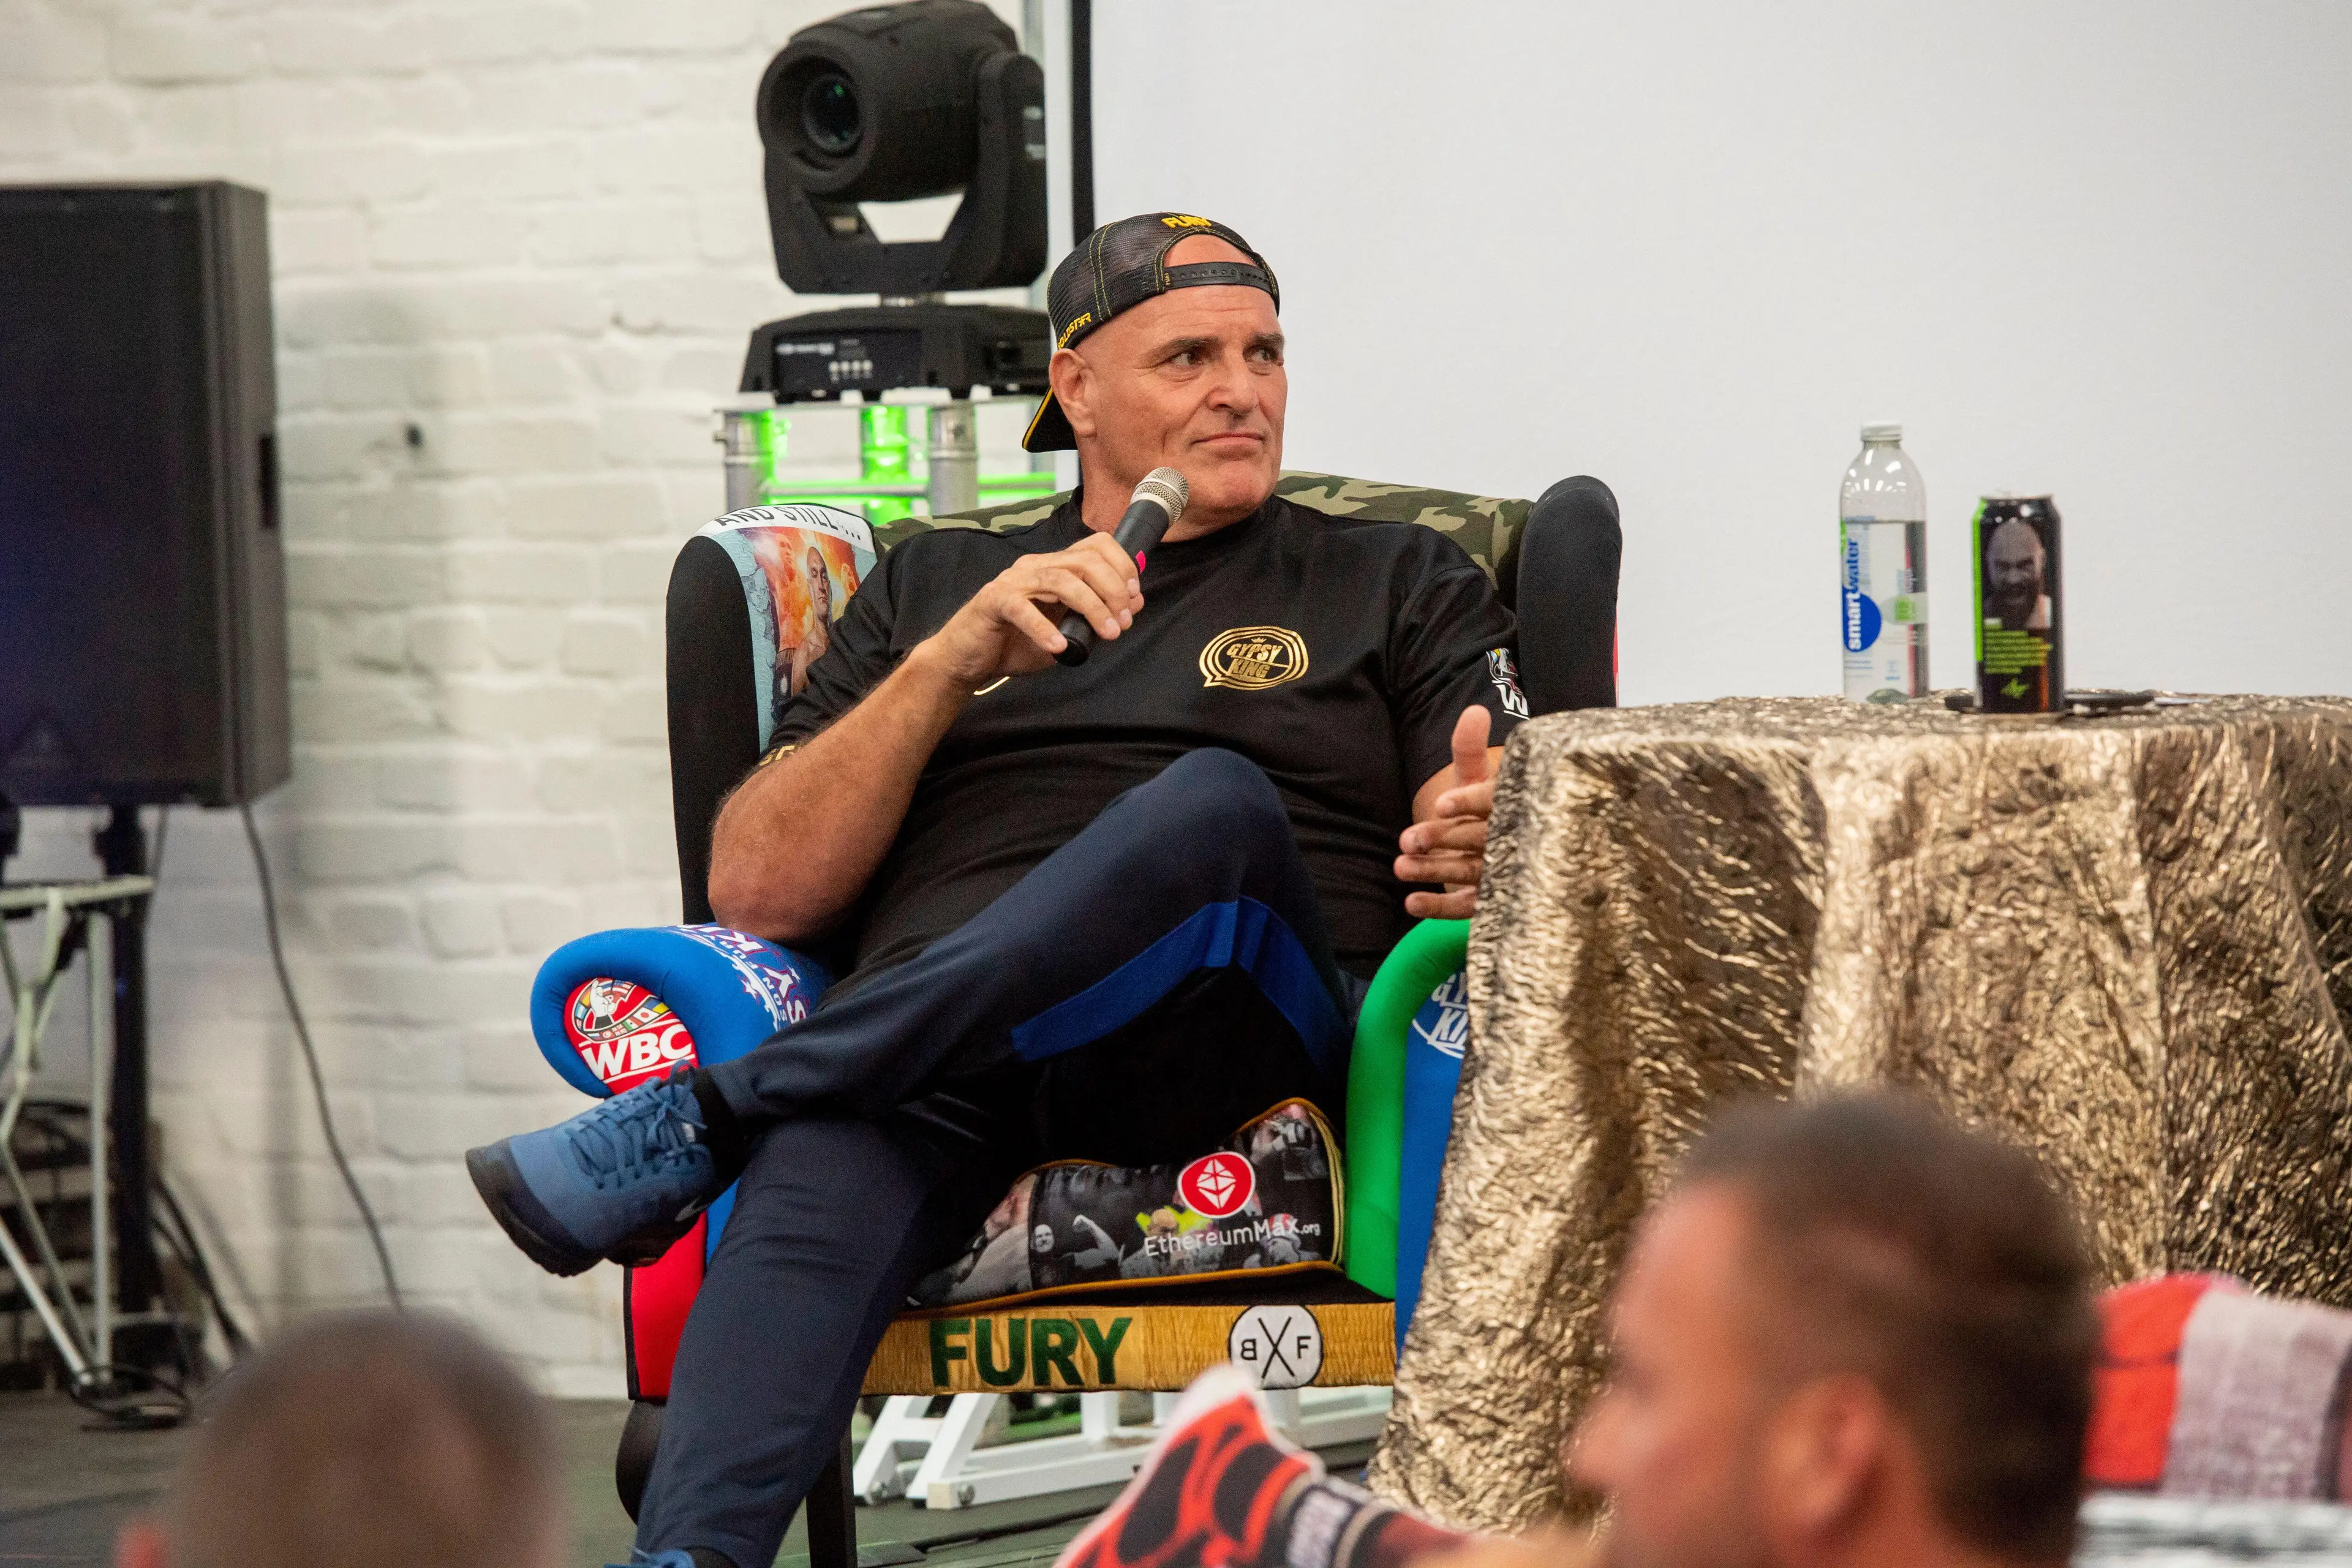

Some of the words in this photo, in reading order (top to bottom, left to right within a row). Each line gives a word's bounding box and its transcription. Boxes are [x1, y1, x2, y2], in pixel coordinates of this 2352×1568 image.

[1161, 216, 1212, 228] FURY
[715, 508, 775, 527] AND
[1226, 643, 1283, 663] GYPSY
[1228, 658, 1271, 678] KING
[582, 1023, 692, 1080] WBC
[1144, 1218, 1321, 1257] EthereumMax.org
[929, 1317, 1133, 1387] FURY
